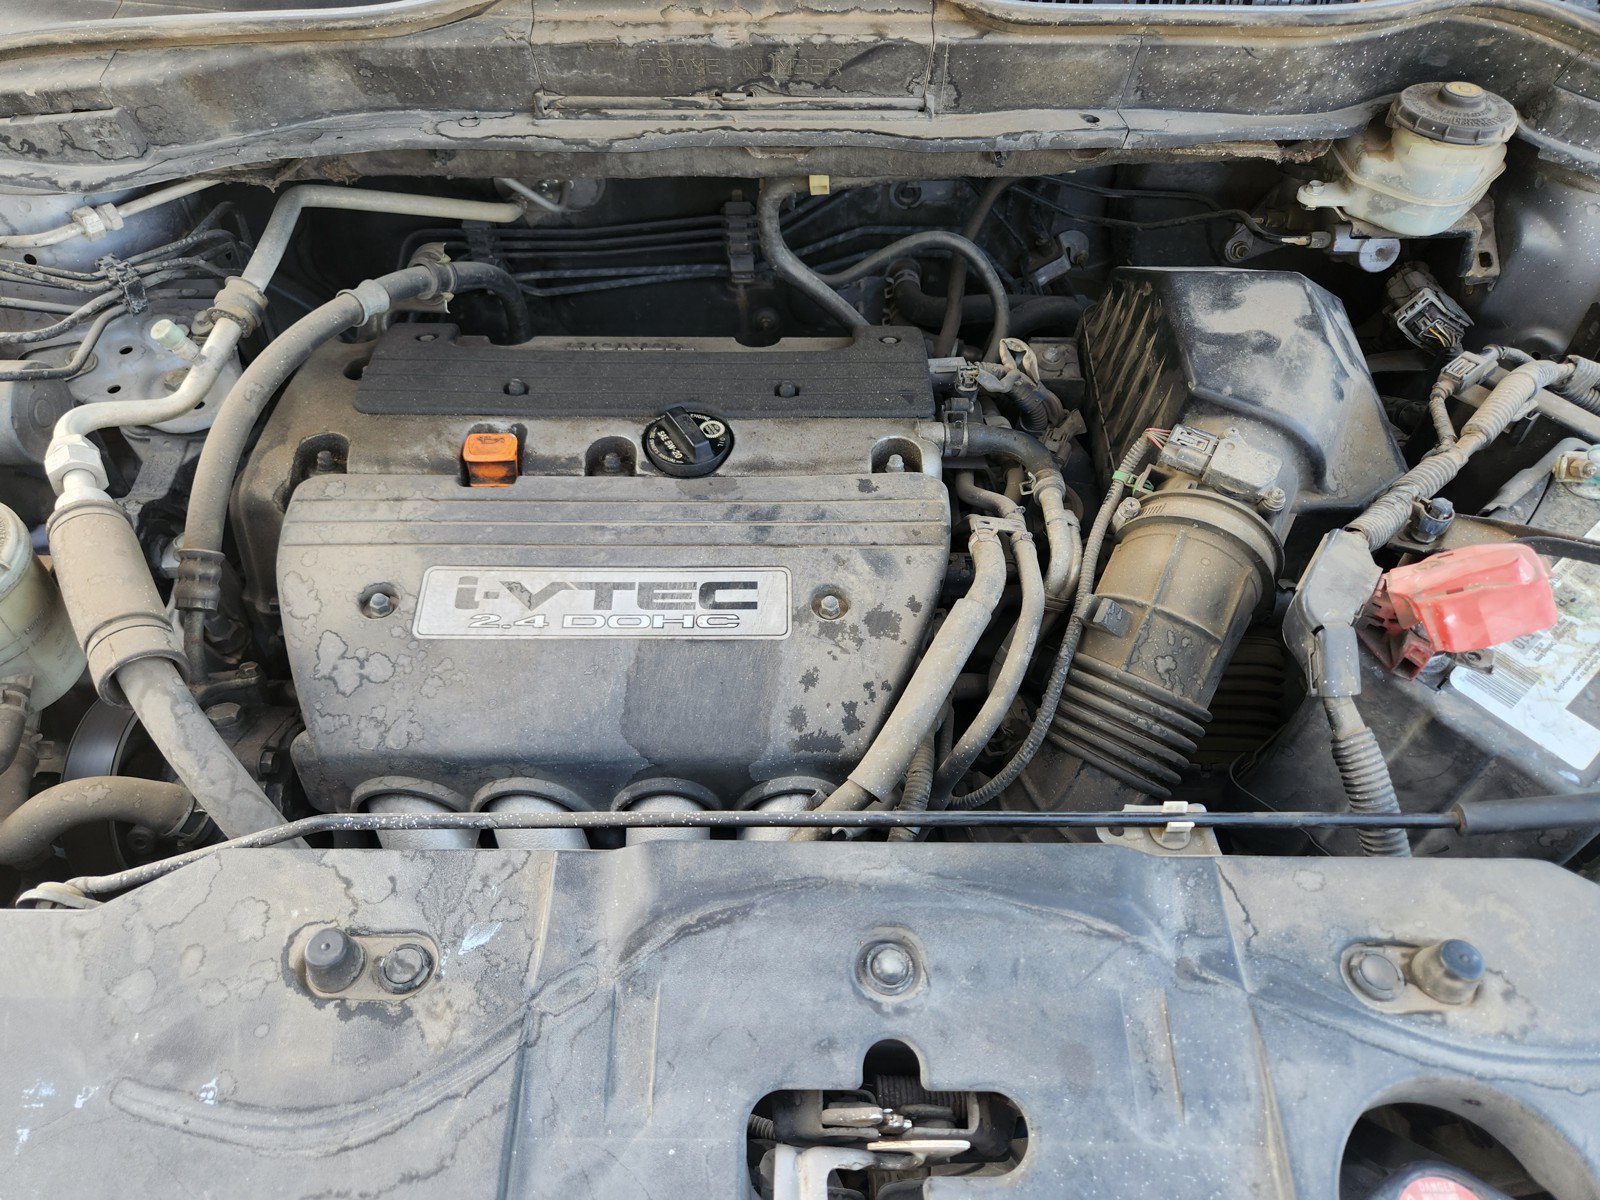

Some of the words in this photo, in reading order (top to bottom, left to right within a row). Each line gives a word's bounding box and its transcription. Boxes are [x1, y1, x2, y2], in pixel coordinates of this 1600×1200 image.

[638, 58, 721, 75] FRAME
[742, 58, 843, 76] NUMBER
[690, 413, 711, 421] ENGINE
[664, 440, 683, 459] 5W-20
[717, 437, 726, 447] OIL
[468, 613, 549, 629] 2.4
[562, 613, 740, 629] DOHC
